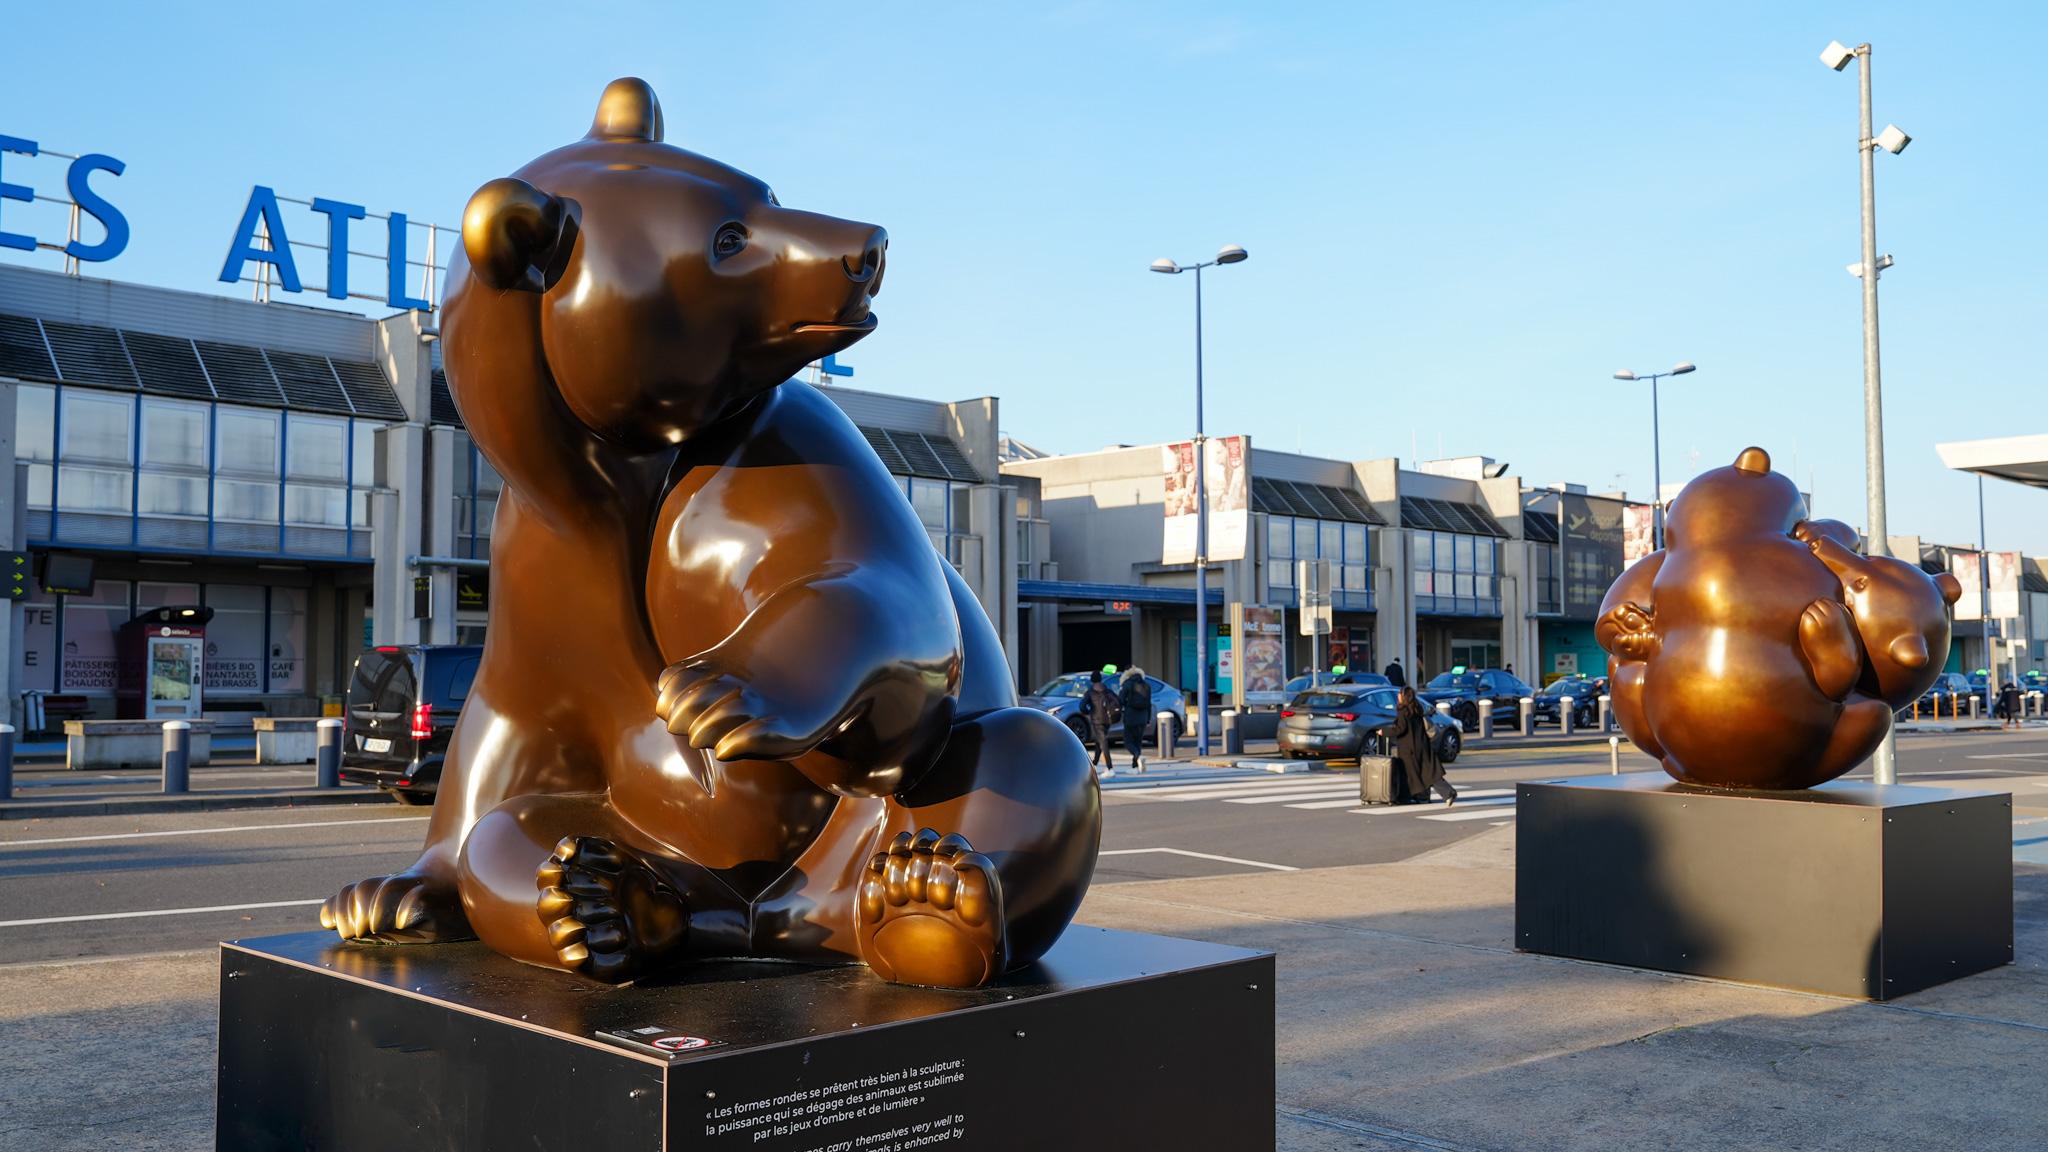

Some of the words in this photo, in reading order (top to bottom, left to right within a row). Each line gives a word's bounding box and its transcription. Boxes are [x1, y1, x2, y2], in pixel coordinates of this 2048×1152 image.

[217, 184, 430, 312] ATL
[206, 661, 236, 671] BIÈRES
[238, 662, 255, 671] BIO
[271, 661, 294, 671] CAFÉ
[65, 670, 116, 678] BOISSONS
[205, 671, 257, 679] NANTAISES
[271, 671, 289, 679] BAR
[65, 679, 113, 687] CHAUDES
[205, 679, 220, 688] LES
[714, 1107, 732, 1119] Les
[734, 1099, 771, 1115] formes
[773, 1091, 808, 1106] rondes
[809, 1088, 821, 1099] se
[822, 1080, 859, 1098] prêtent
[860, 1076, 879, 1088] très
[880, 1071, 901, 1084] bien
[902, 1069, 908, 1079] à
[909, 1068, 918, 1078] la
[705, 1125, 716, 1136] la
[718, 1114, 772, 1136] puissance
[773, 1107, 791, 1123] qui
[792, 1106, 804, 1117] se
[806, 1098, 844, 1115] dégage
[846, 1093, 864, 1106] des
[865, 1085, 907, 1101] animaux
[908, 1081, 922, 1092] est
[923, 1072, 965, 1089] sublimée
[753, 1129, 772, 1143] par
[773, 1124, 788, 1137] les
[789, 1119, 812, 1136] jeux
[813, 1109, 855, 1128] d'ombre
[856, 1107, 867, 1118] et
[868, 1103, 881, 1115] de
[883, 1095, 919, 1112] lumière
[826, 1140, 853, 1152] carry
[855, 1128, 909, 1147] themselves
[911, 1121, 932, 1134] very
[934, 1115, 953, 1129] well
[954, 1113, 965, 1124] to
[893, 1142, 902, 1152] is
[904, 1129, 951, 1150] enhanced
[952, 1127, 965, 1140] by
